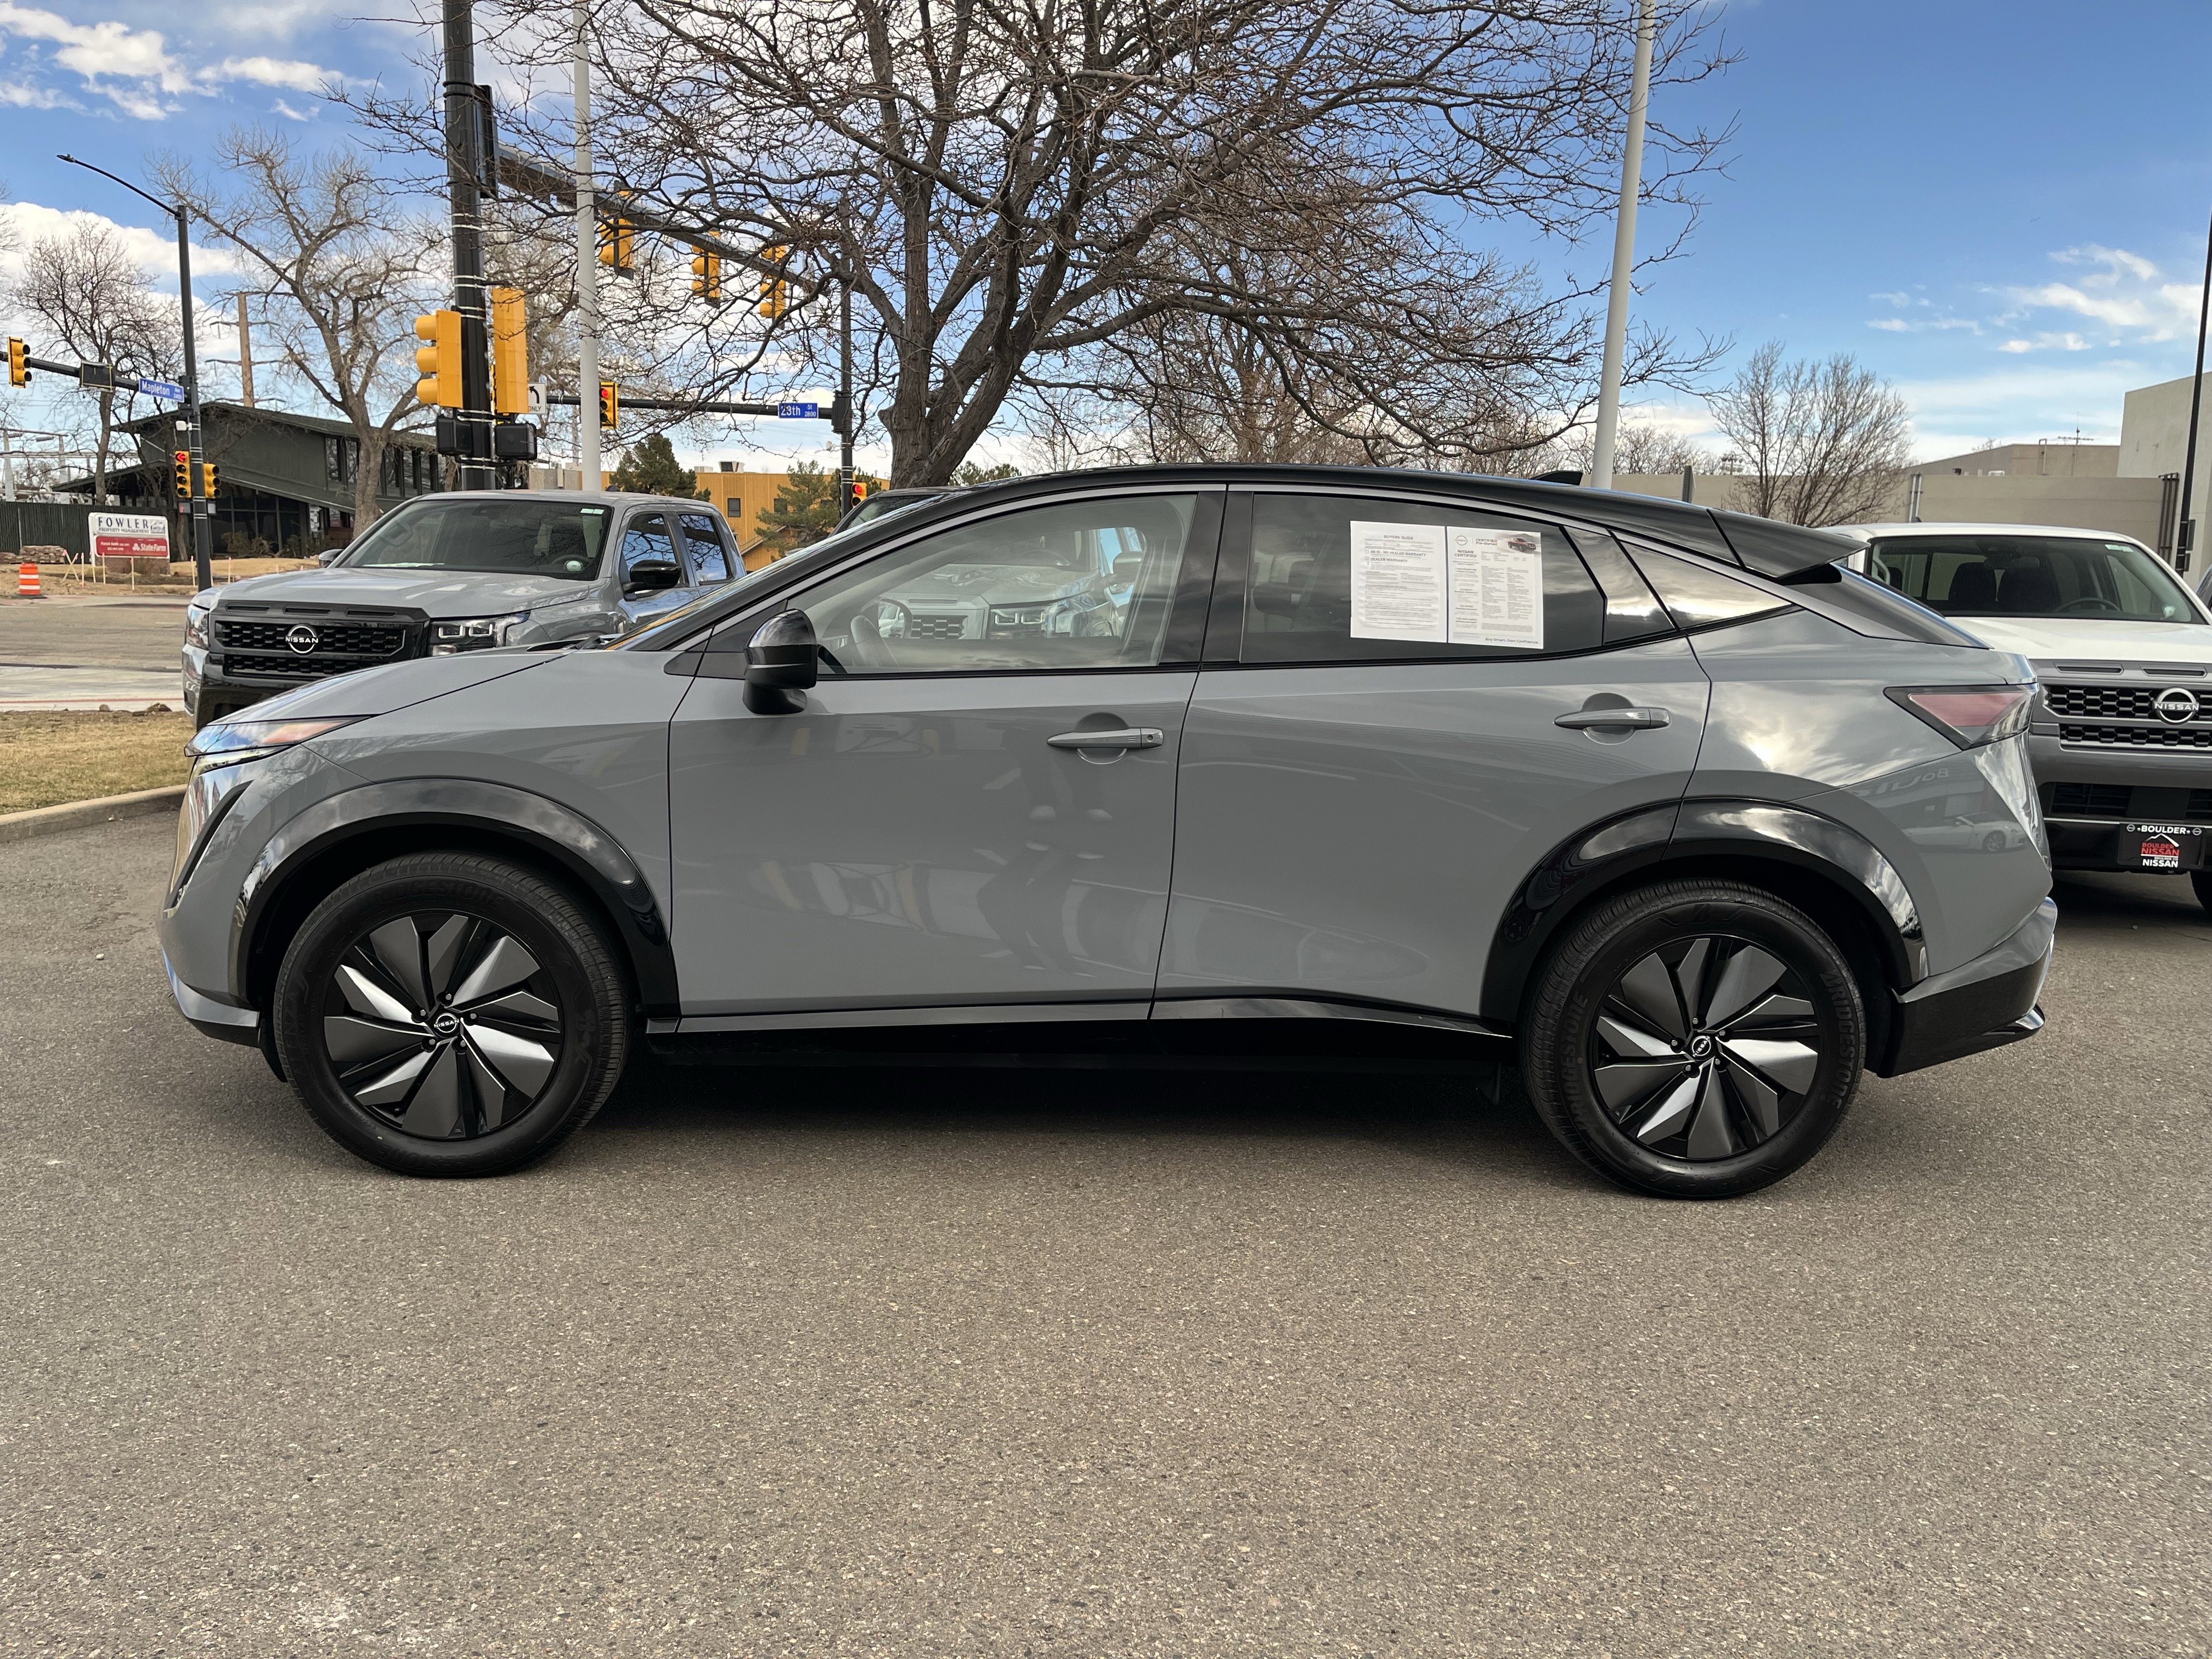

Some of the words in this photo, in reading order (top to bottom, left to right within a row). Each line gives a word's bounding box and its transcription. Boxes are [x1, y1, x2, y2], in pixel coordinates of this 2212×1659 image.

[142, 380, 170, 396] Mapleton
[98, 517, 149, 528] FOWLER
[2154, 703, 2199, 711] NISSAN
[2141, 825, 2186, 834] BOULDER
[2142, 859, 2178, 868] NISSAN
[368, 879, 504, 909] RIDGESTONE
[433, 1019, 460, 1028] NISSAN
[1819, 971, 1856, 1109] BRIDGESTONE
[1560, 991, 1589, 1131] BRIDGESTONE
